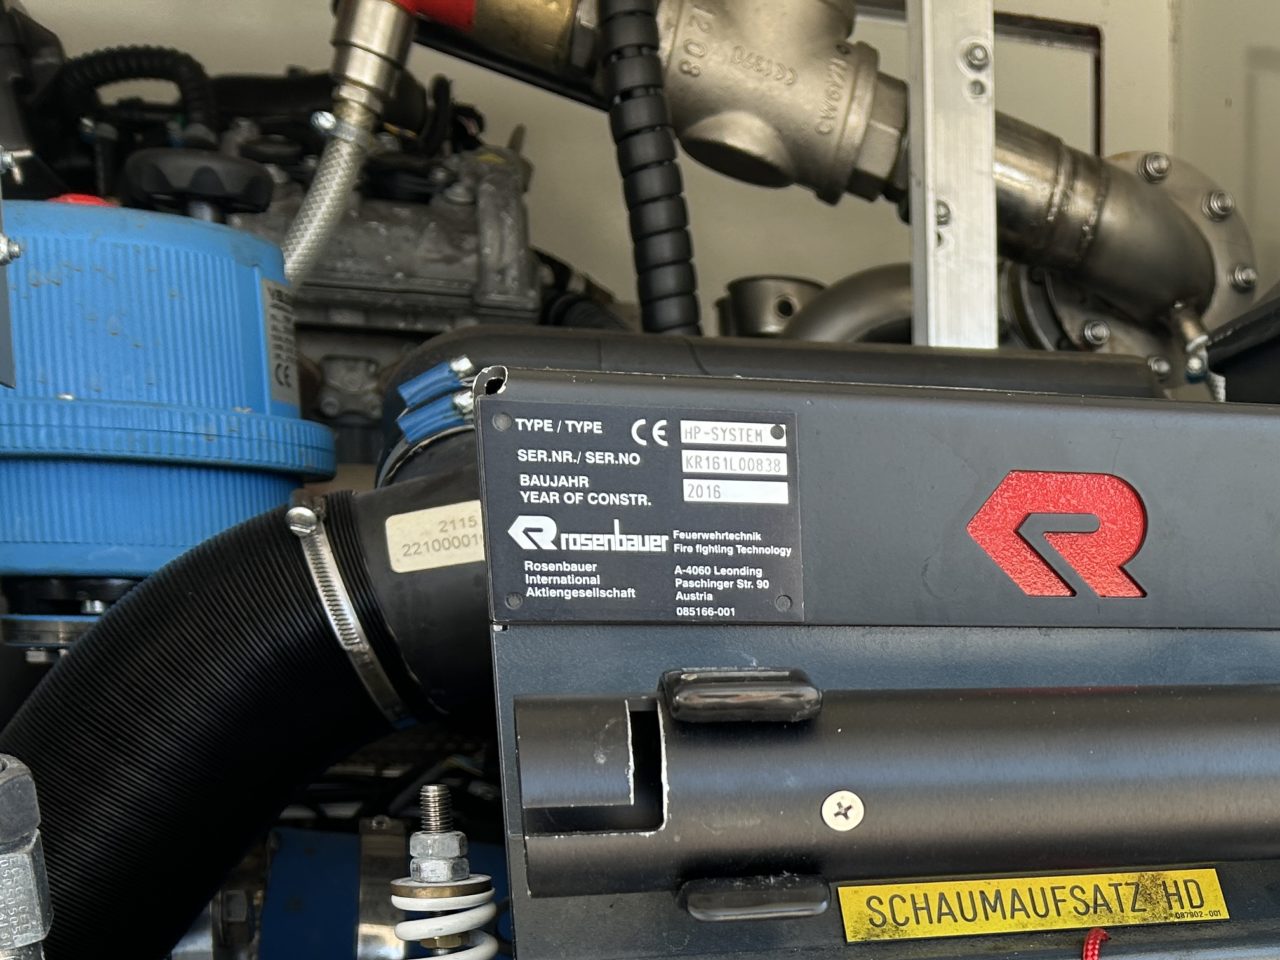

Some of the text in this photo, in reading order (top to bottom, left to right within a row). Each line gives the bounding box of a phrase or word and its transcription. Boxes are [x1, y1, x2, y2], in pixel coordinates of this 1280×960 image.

[516, 419, 553, 432] TYPE
[565, 421, 602, 434] TYPE
[684, 427, 763, 443] HP-SYSTEM
[518, 450, 640, 465] SER.NR./ SER.NO
[520, 475, 589, 488] BAUJAHR
[688, 484, 721, 499] 2016
[521, 491, 651, 506] YEAR OF CONSTR.
[440, 516, 477, 532] 2115
[673, 531, 761, 541] Feuerwehrtechnik
[402, 534, 482, 556] 22100001
[674, 544, 791, 556] Fire fighting Technology
[525, 561, 597, 571] Rosenbauer
[675, 566, 762, 578] A-4060 Leonding
[526, 574, 600, 585] International
[675, 579, 769, 590] Paschinger Str. 90
[526, 587, 636, 599] Aktiengesellschaft
[676, 592, 713, 601] Austria
[677, 608, 735, 616] 085166-001
[866, 879, 1205, 928] SCHAUMAUFSATZ HD
